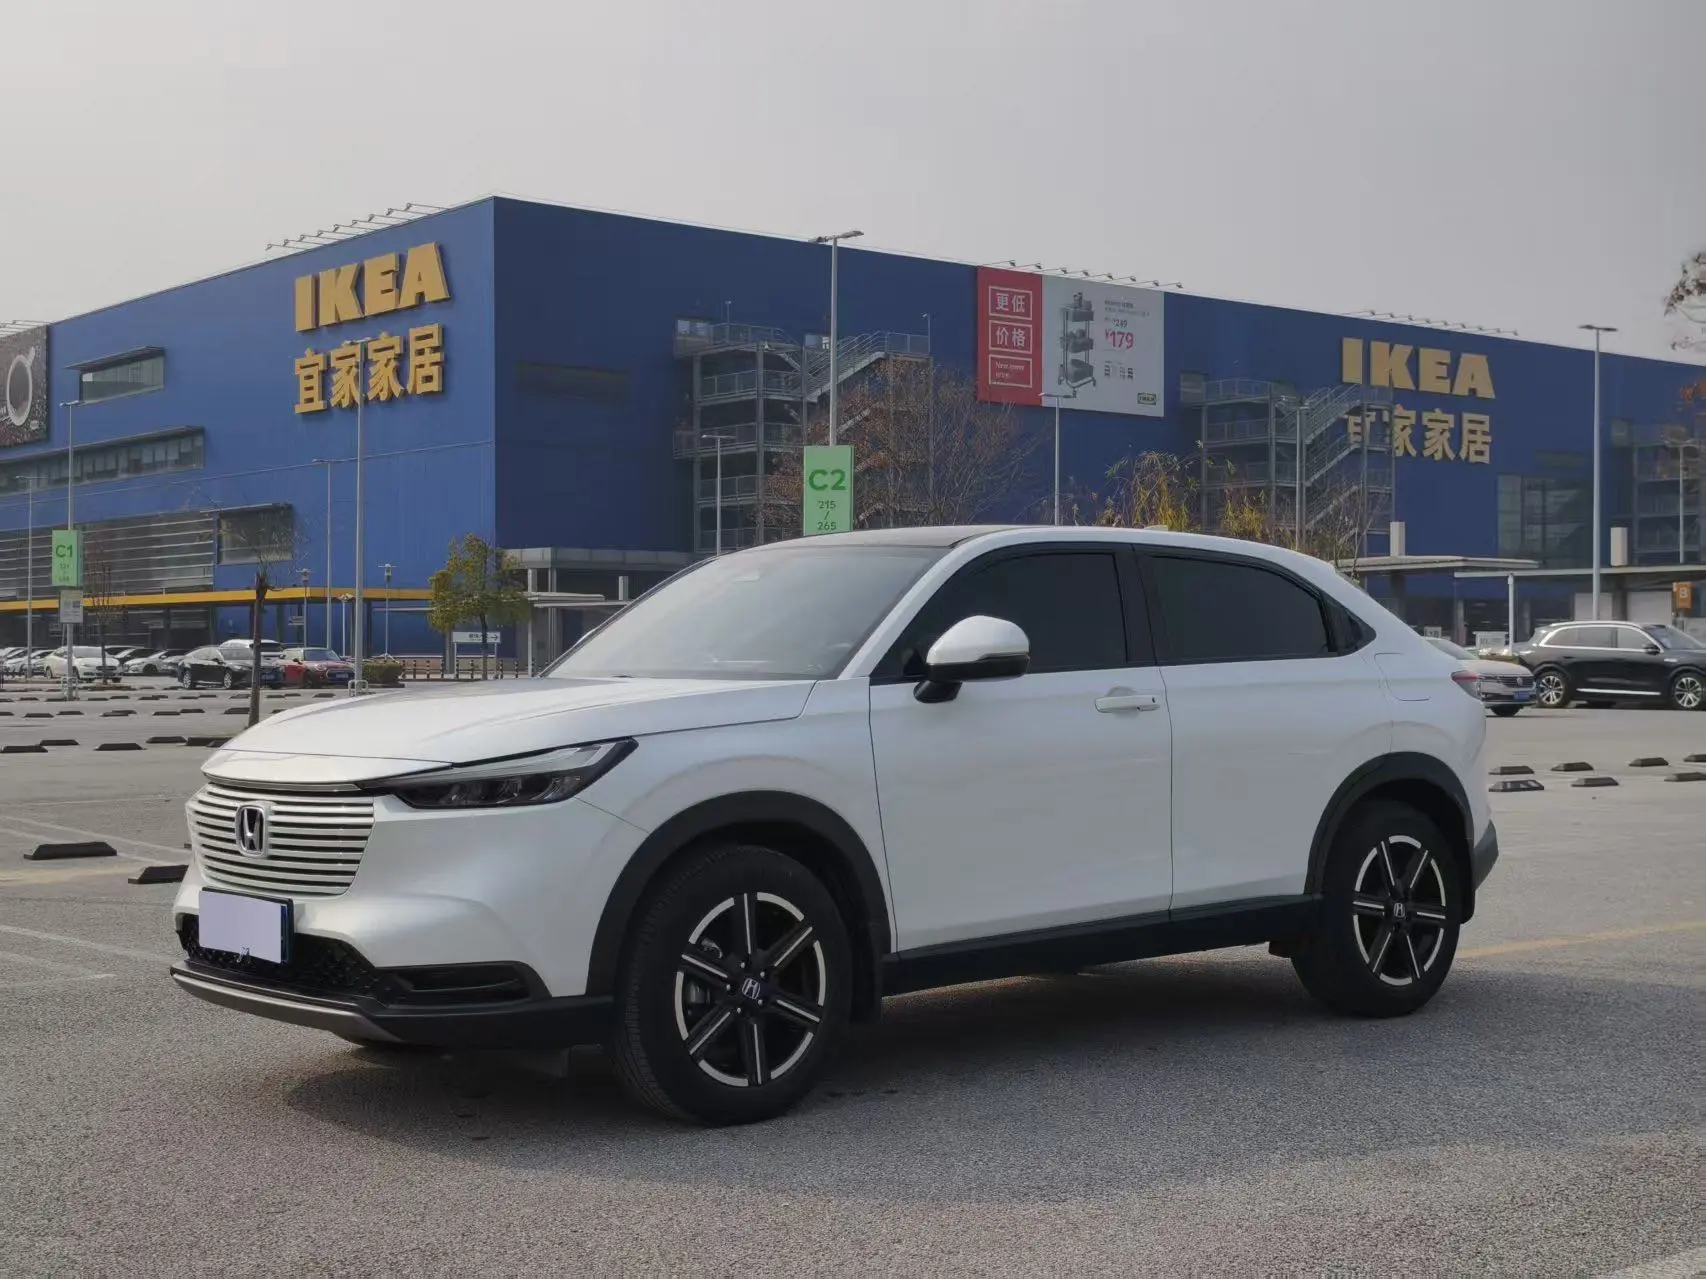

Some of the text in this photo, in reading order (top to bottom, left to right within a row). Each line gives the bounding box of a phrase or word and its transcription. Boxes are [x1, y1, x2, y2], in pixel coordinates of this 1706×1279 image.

[295, 242, 450, 332] IKEA
[995, 292, 1025, 313] 更低
[995, 326, 1026, 347] 价格
[1104, 329, 1134, 349] ¥179
[294, 323, 445, 413] 宜家家居
[1342, 337, 1495, 399] IKEA
[808, 469, 846, 491] C2
[818, 500, 837, 509] 215
[817, 522, 837, 531] 265
[55, 544, 73, 558] C1
